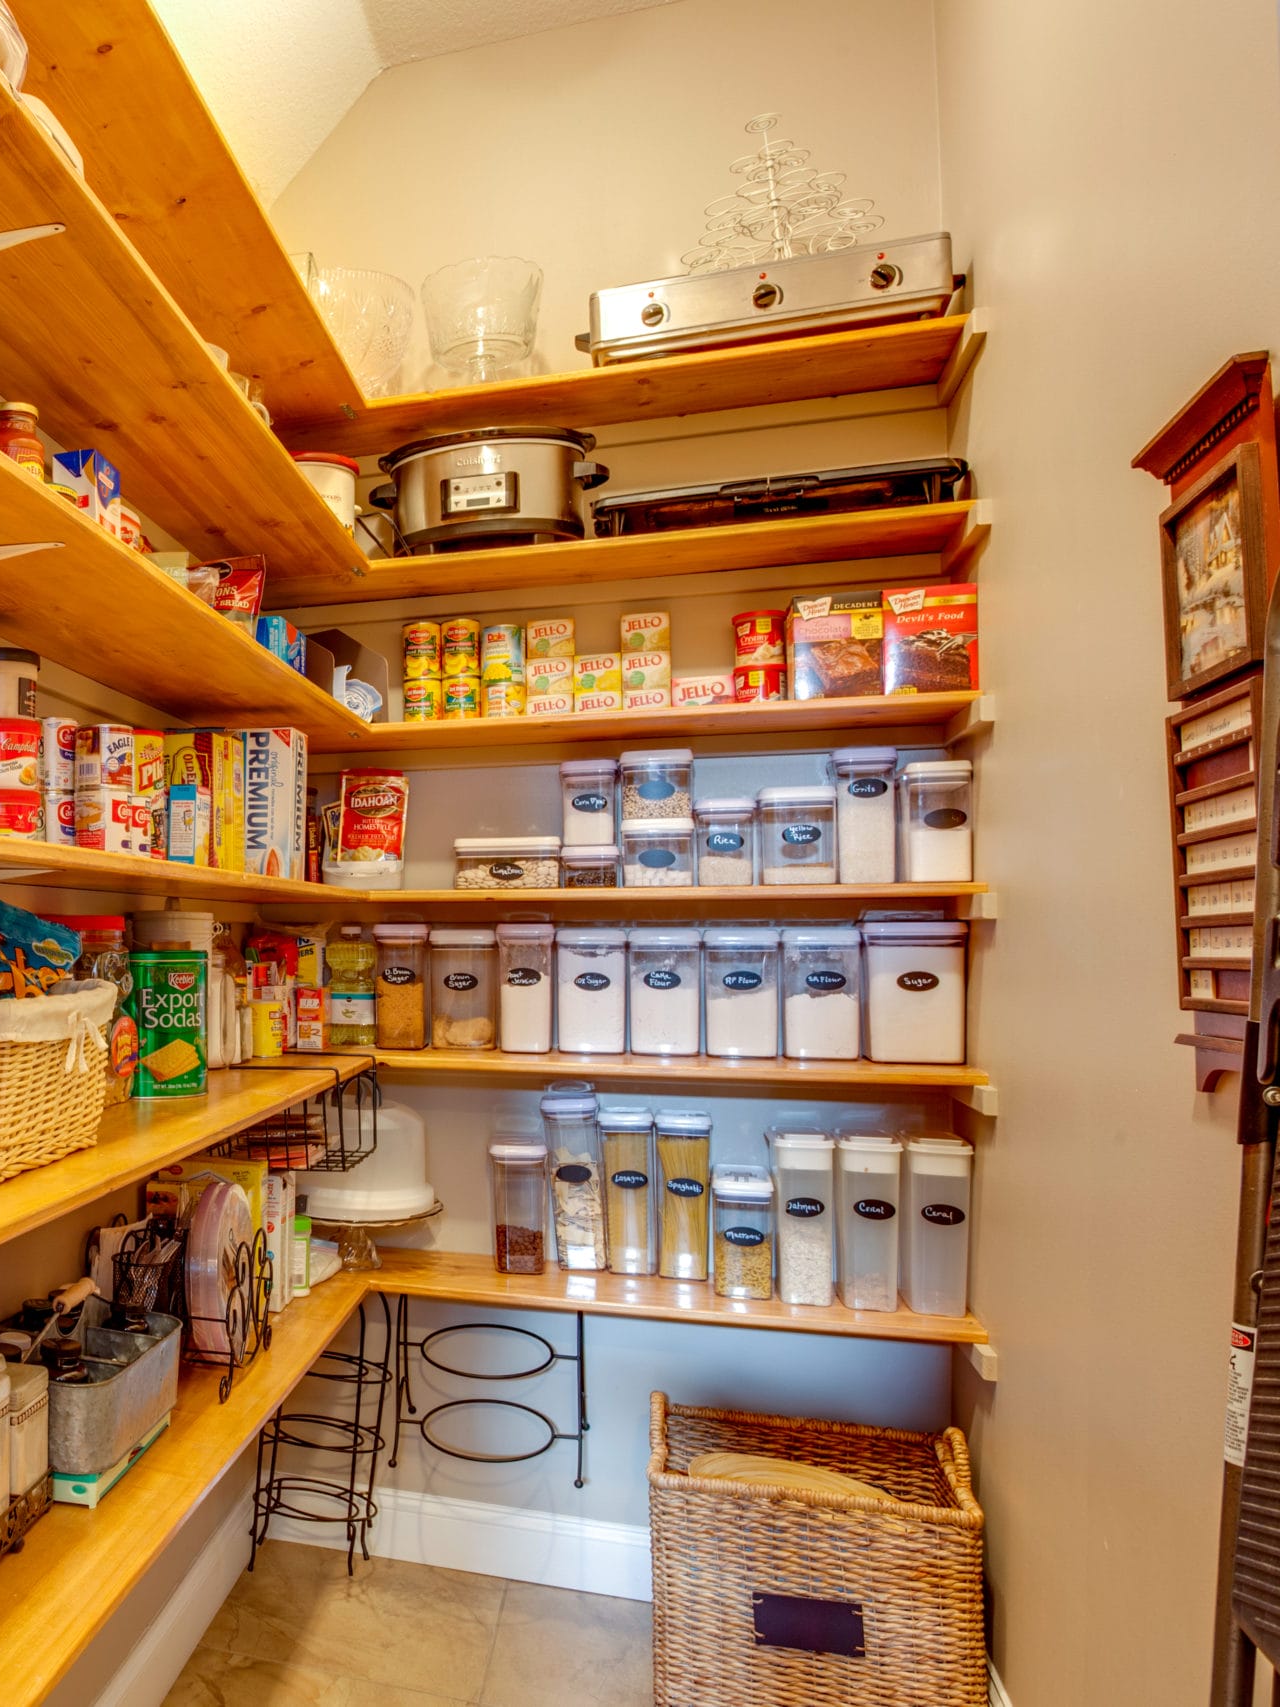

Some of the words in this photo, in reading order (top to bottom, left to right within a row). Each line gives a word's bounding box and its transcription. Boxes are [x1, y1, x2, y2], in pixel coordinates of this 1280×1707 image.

[220, 599, 250, 609] BREAD
[803, 600, 830, 612] Duncan
[833, 601, 879, 610] DECADENT
[806, 607, 826, 617] Hines
[896, 613, 934, 624] Devil's
[938, 611, 964, 621] Food
[625, 616, 662, 633] JELL-O
[799, 625, 849, 635] Chocolate
[532, 623, 567, 640] JELL-O
[740, 633, 769, 644] Creamy
[578, 657, 614, 674] JELL-O
[625, 654, 663, 671] JELL-O
[531, 661, 567, 677] JELL-O
[679, 681, 725, 702] JELL-O
[531, 698, 566, 714] JELL-O
[579, 695, 615, 711] JELL-O
[627, 692, 664, 709] JELL-O
[270, 751, 284, 787] original
[247, 732, 271, 850] PREMIUM
[295, 735, 304, 851] PREMIUM
[852, 784, 876, 793] Grits
[351, 794, 398, 808] IDAHOAN
[574, 798, 589, 806] Corn
[354, 823, 391, 831] HOMESTYLE
[789, 825, 814, 834] Yellow
[714, 835, 737, 846] Rice
[793, 832, 814, 842] Rice
[170, 974, 195, 985] Keebler
[387, 974, 410, 984] Sugar
[449, 974, 471, 982] Brown
[586, 976, 608, 987] Sugar
[650, 978, 671, 987] Flour
[904, 977, 932, 987] Sugar
[449, 980, 472, 989] Sugar
[142, 989, 204, 1013] Export
[144, 1008, 201, 1029] Sodas
[667, 1181, 702, 1193] Spaghetti
